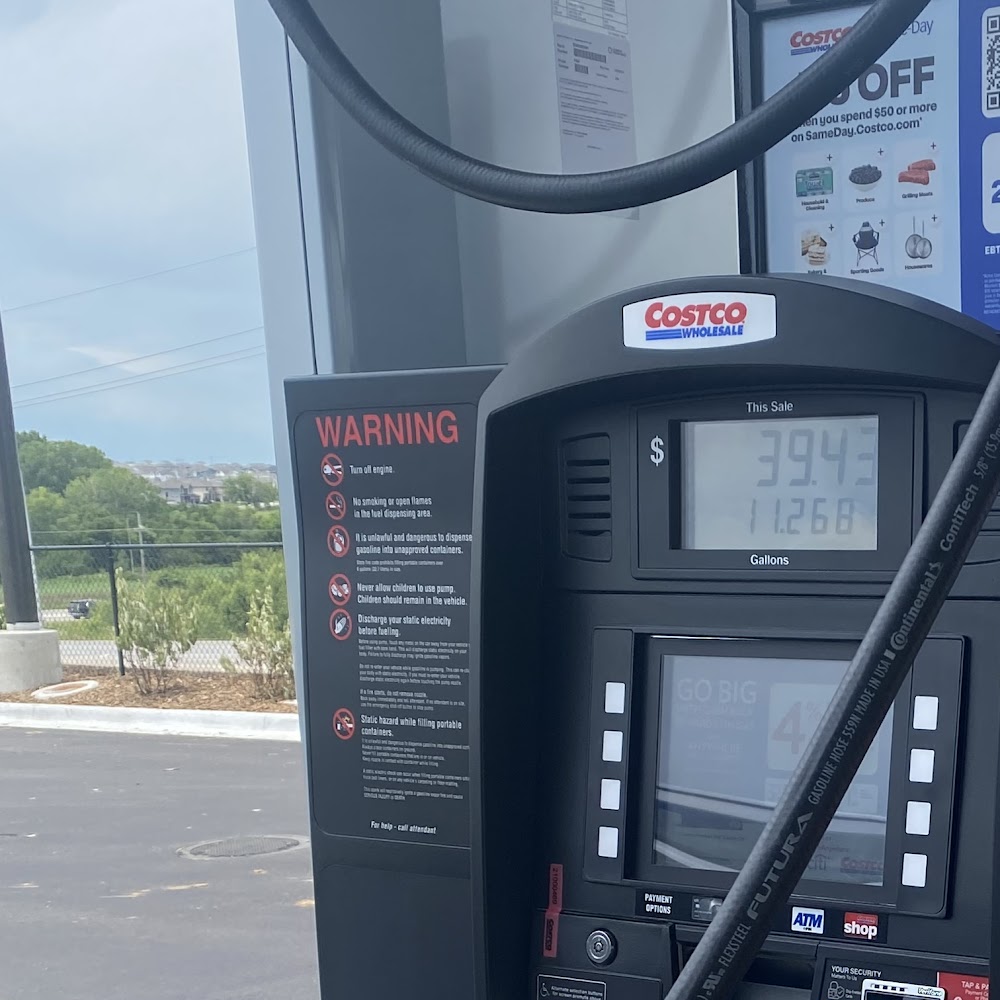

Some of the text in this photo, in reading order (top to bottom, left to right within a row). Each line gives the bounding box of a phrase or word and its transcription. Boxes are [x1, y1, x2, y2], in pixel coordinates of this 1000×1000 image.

[857, 56, 935, 101] OFF
[819, 102, 937, 128] you spend $50 or more
[791, 131, 804, 143] on
[985, 245, 1000, 255] EBT
[645, 302, 747, 328] COSTCO
[681, 325, 744, 339] WHOLESALE
[746, 401, 794, 413] This Sale
[315, 409, 459, 448] WARNING
[650, 435, 665, 467] $
[350, 464, 395, 475] Turn off engine.
[353, 497, 362, 506] No
[362, 497, 387, 508] smoking
[396, 499, 410, 508] open
[411, 496, 432, 506] flames
[940, 483, 979, 552] ContiTech
[750, 553, 790, 566] Gallons
[679, 679, 757, 704] GO BIG
[807, 760, 838, 806] GASOLINE
[829, 736, 849, 768] HOSE
[856, 686, 875, 716] MADE
[867, 675, 881, 691] IN
[874, 660, 892, 681] USA
[747, 810, 814, 921] FUTURA
[645, 893, 673, 905] PAYMENT
[645, 903, 671, 915] OPTIONS
[793, 912, 823, 928] ATM
[844, 921, 878, 939] shop
[718, 922, 752, 968] FLEXSTEEL
[831, 965, 882, 978] YOUR SECURITY
